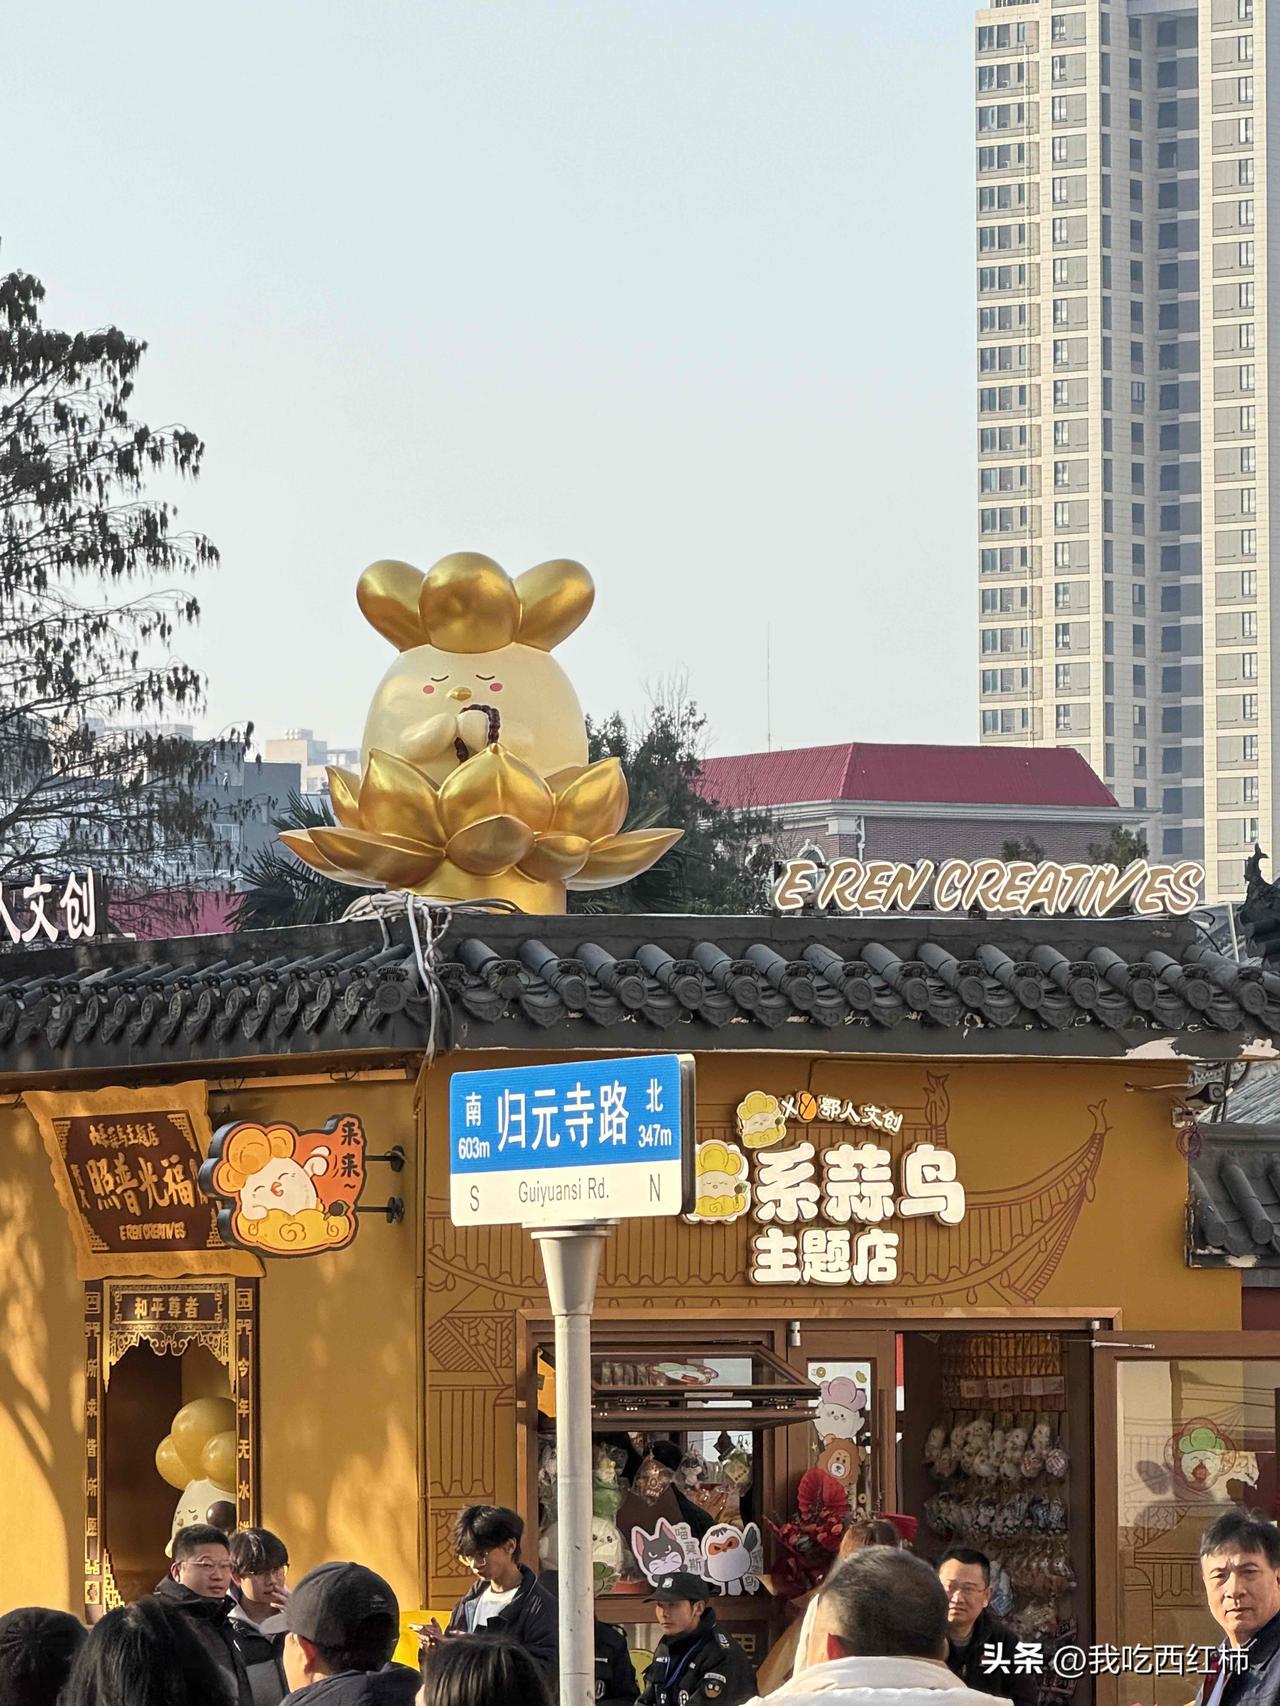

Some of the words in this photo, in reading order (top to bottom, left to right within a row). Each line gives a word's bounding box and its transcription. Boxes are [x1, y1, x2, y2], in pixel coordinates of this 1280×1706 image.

[774, 859, 817, 911] E
[818, 858, 934, 913] REN
[933, 857, 1206, 916] CREATIVES
[465, 1091, 482, 1127] 南
[497, 1080, 630, 1152] 归元寺路
[645, 1078, 664, 1113] 北
[818, 1096, 904, 1135] 鄂人文创
[458, 1137, 490, 1160] 603m
[638, 1124, 672, 1148] 347m
[469, 1184, 480, 1212] S
[518, 1177, 582, 1207] Guiyuansi
[587, 1176, 610, 1200] Rd.
[649, 1173, 661, 1203] N
[685, 1142, 966, 1225] 系蒜鸟
[752, 1227, 899, 1285] 主题店
[134, 1295, 200, 1320] 和平尊者
